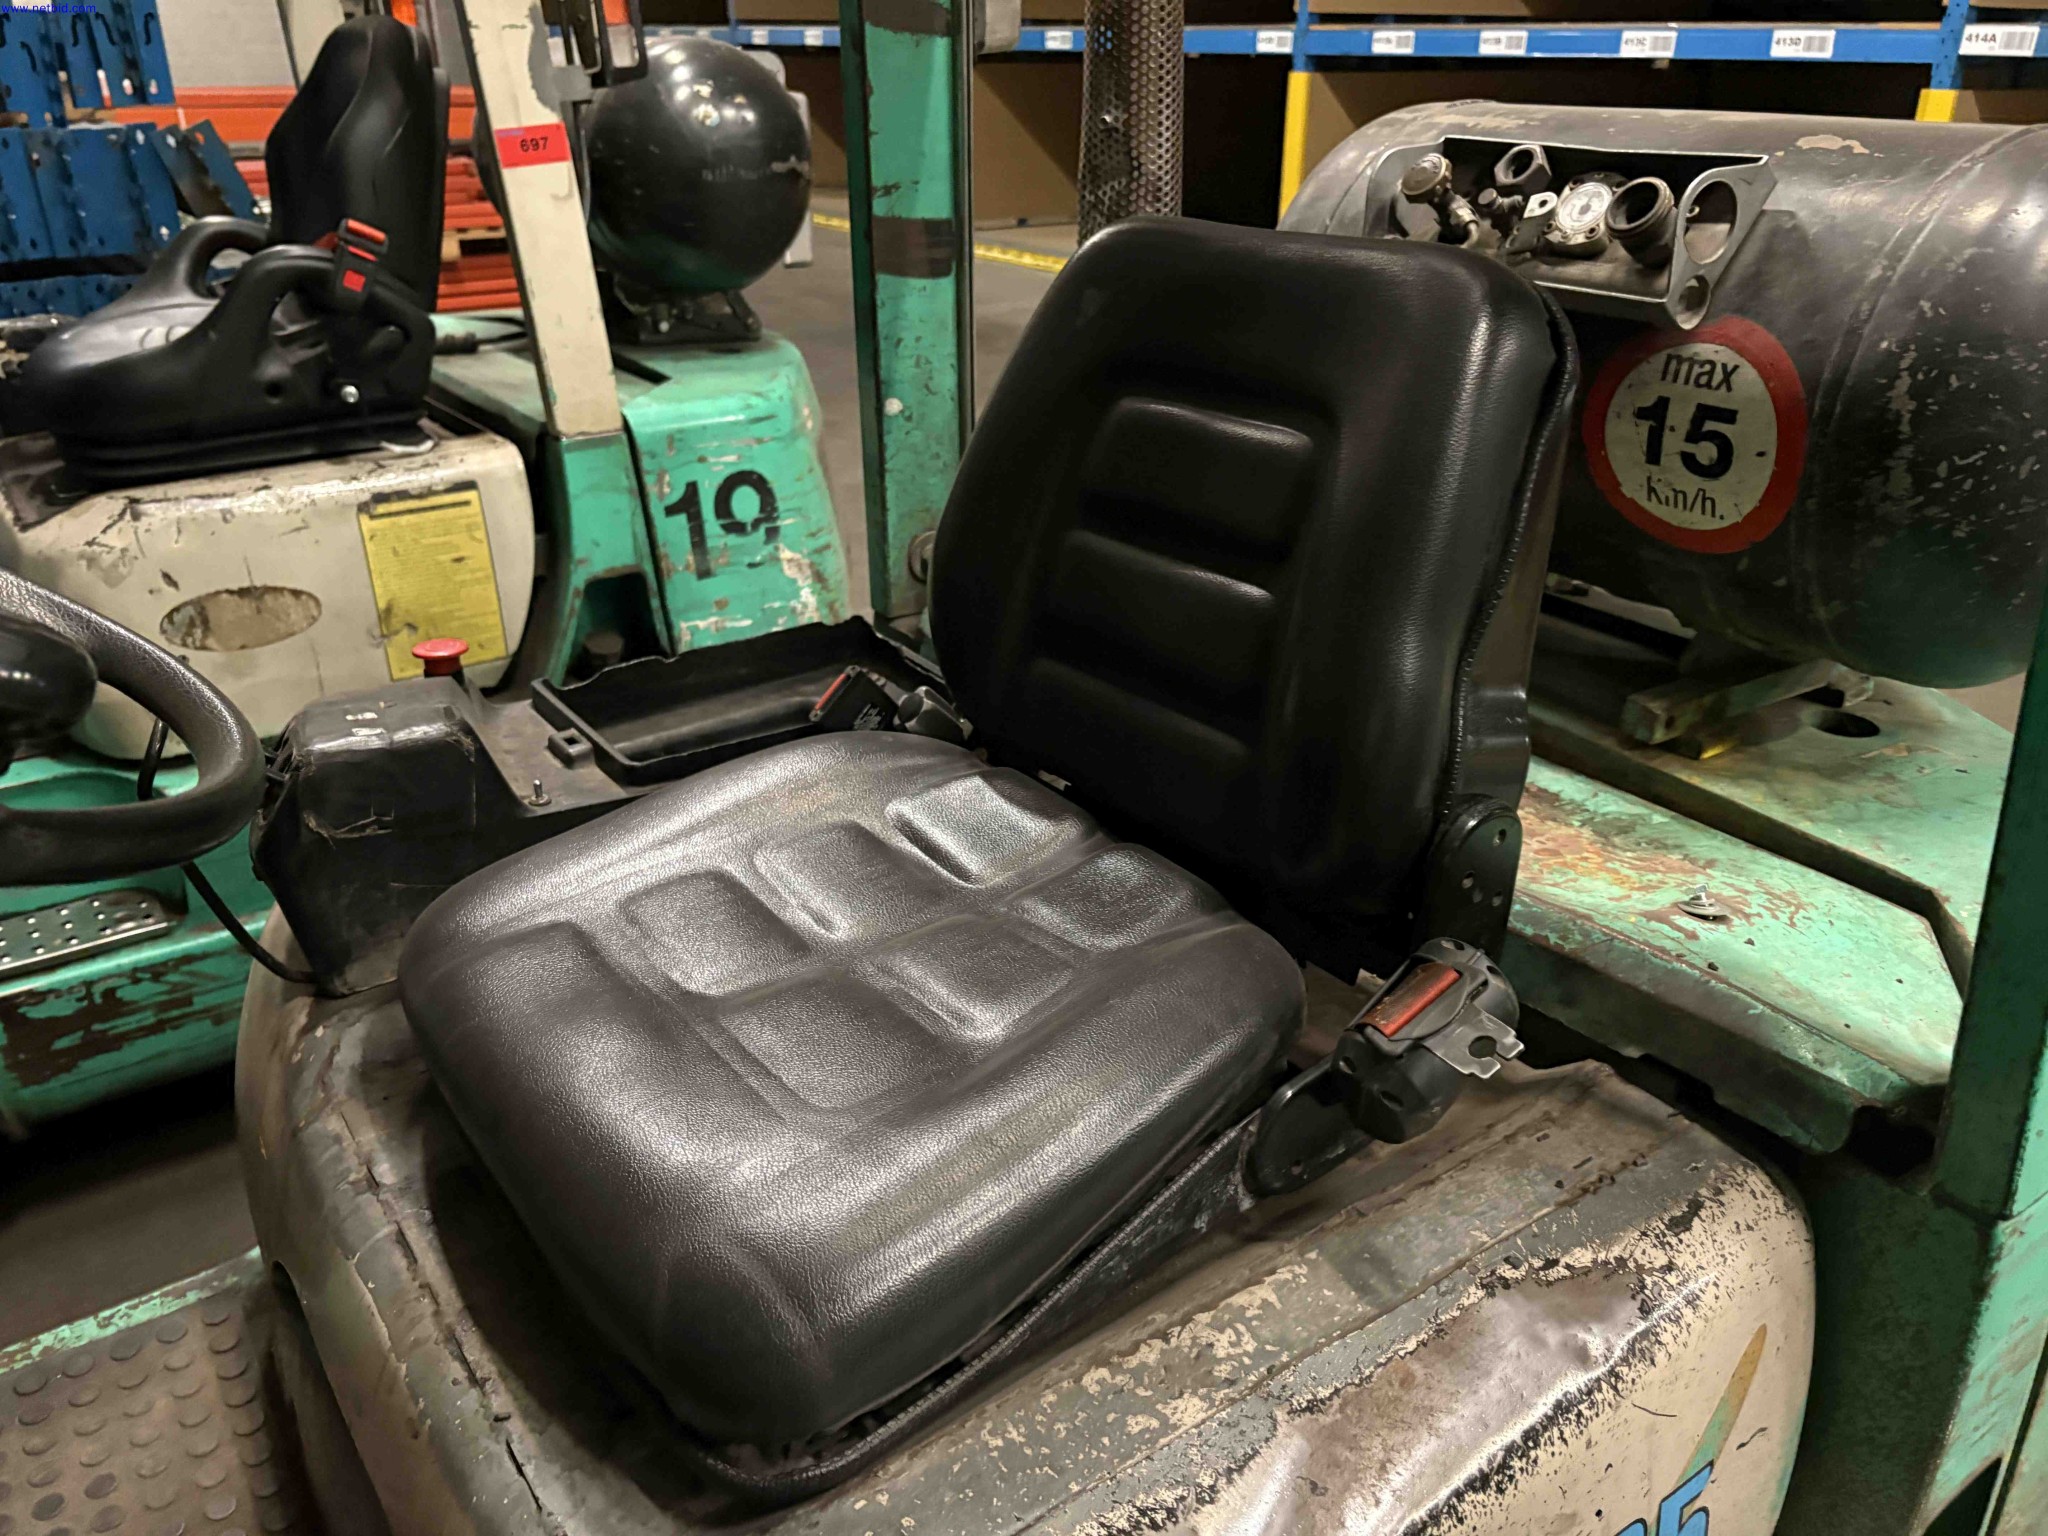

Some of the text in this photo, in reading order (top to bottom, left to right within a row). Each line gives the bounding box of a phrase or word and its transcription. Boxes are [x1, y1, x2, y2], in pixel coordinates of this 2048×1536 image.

[1965, 33, 1997, 43] 414A
[520, 136, 549, 153] 697
[1660, 352, 1740, 393] max
[1632, 395, 1739, 480] 15
[664, 469, 781, 581] 19
